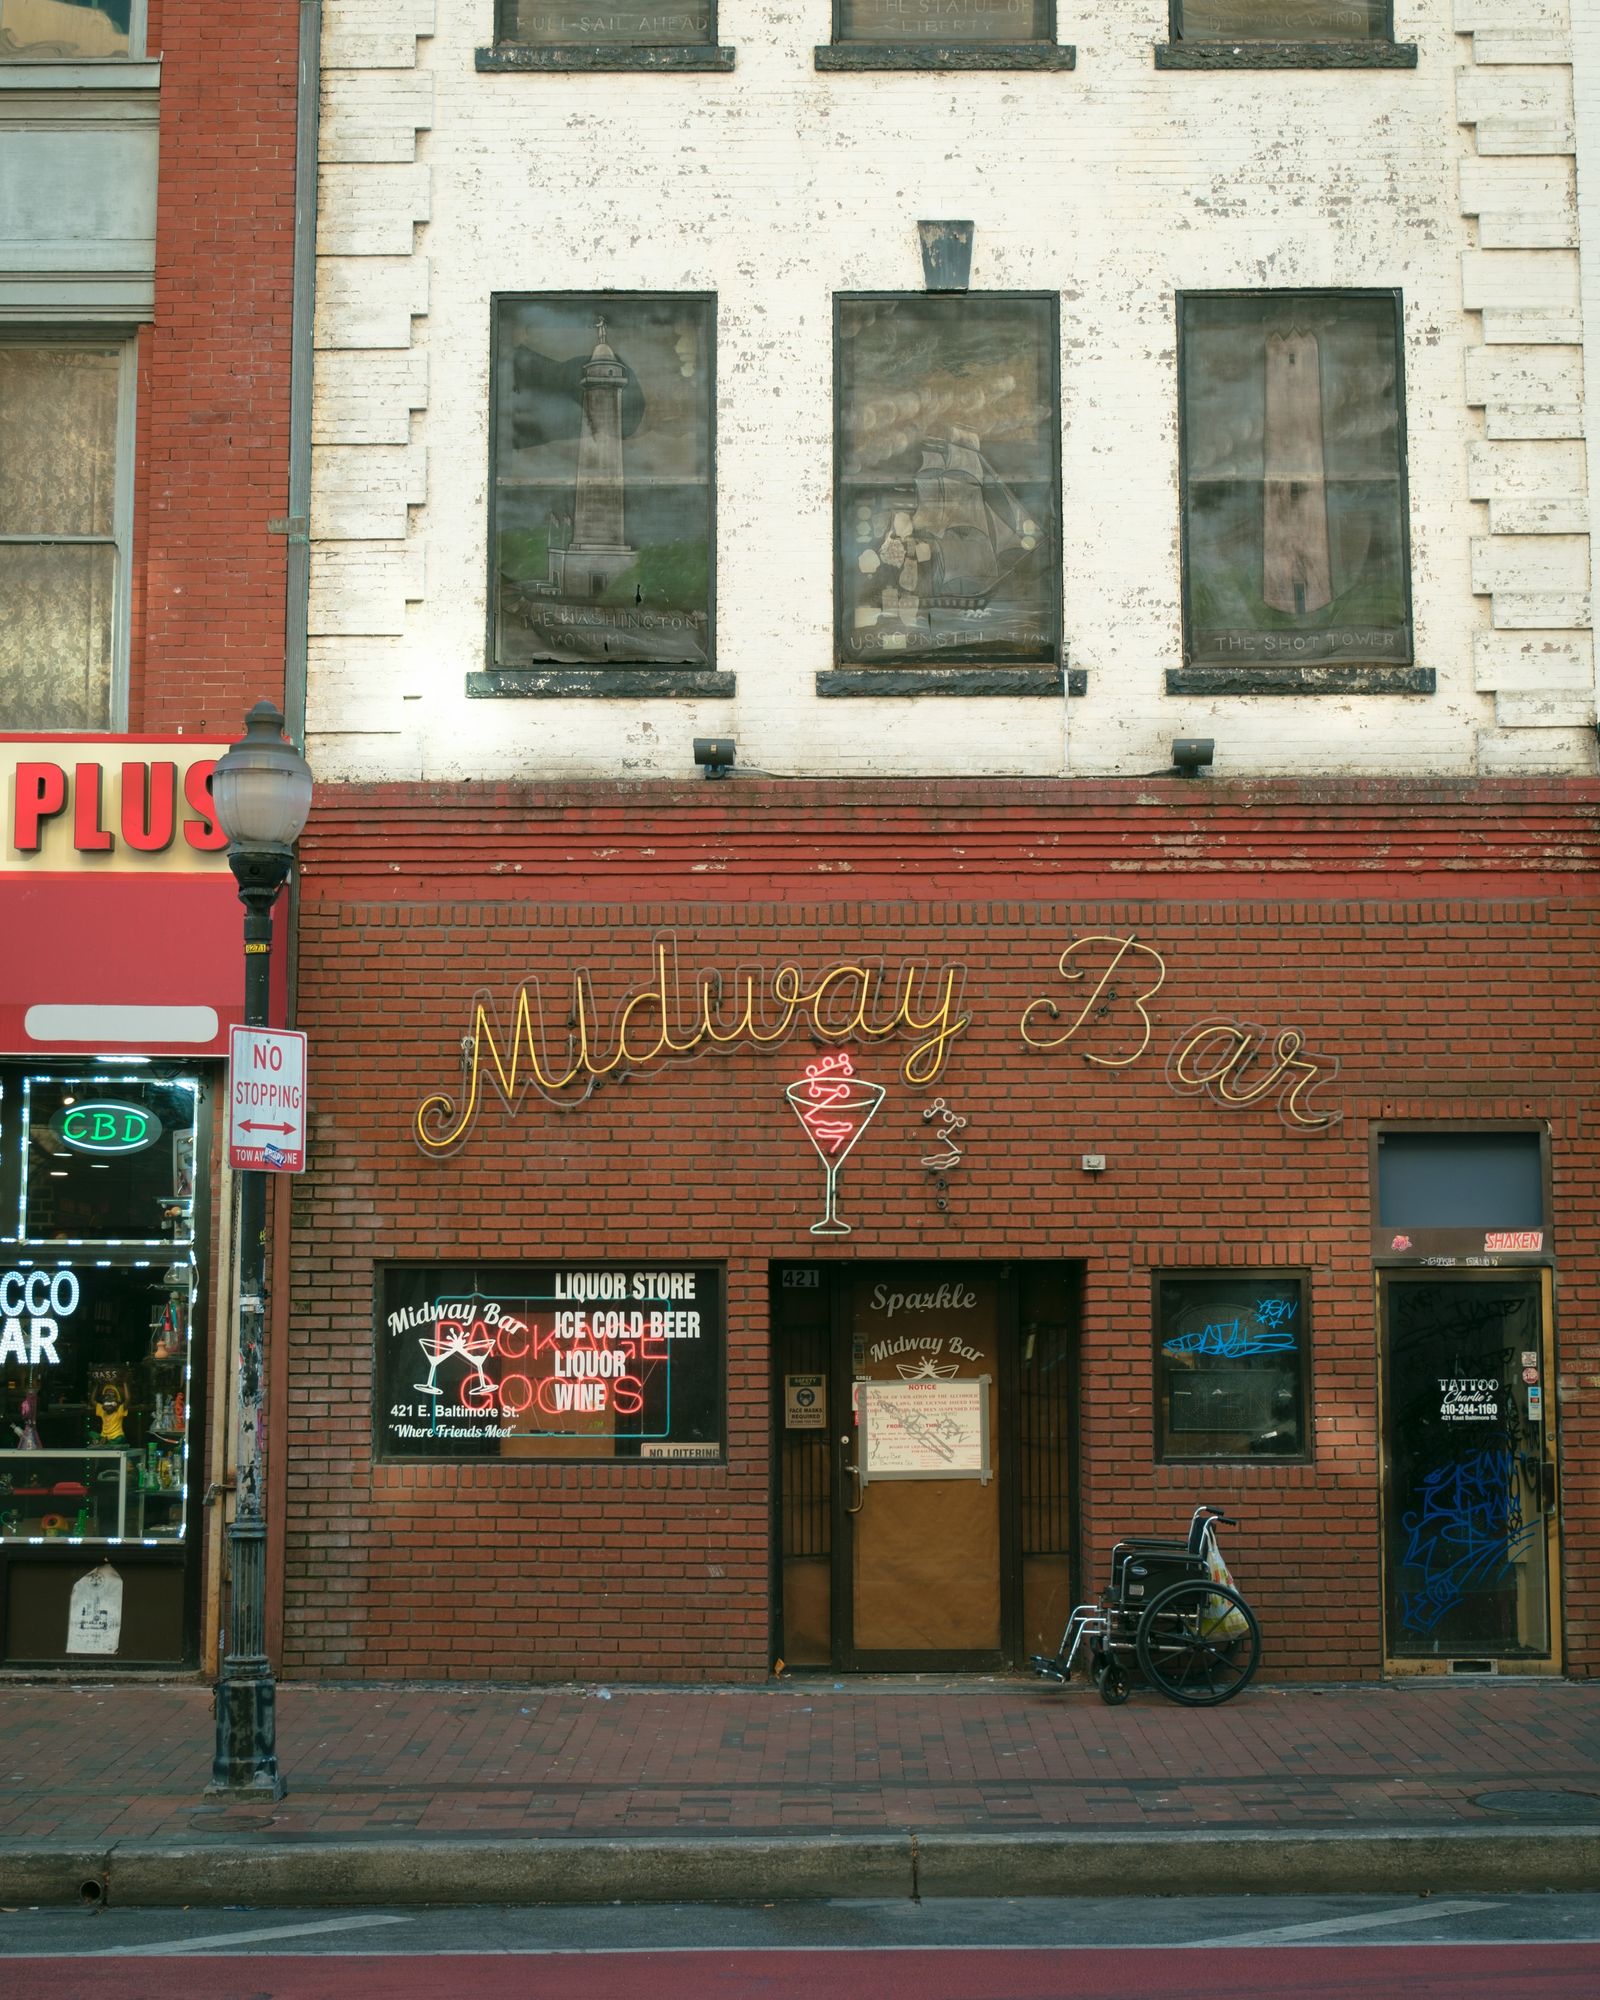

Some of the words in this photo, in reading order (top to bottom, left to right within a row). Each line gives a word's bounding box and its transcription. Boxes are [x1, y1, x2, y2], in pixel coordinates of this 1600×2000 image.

[639, 15, 708, 31] AHEAD
[902, 20, 993, 32] LIBERTY
[521, 611, 564, 629] THE
[571, 615, 699, 631] WASHINGTON
[1214, 637, 1255, 650] THE
[1264, 636, 1319, 651] SHOT
[1326, 633, 1394, 648] TOWER
[14, 759, 231, 852] PLUS
[415, 931, 970, 1155] Midway
[1021, 934, 1341, 1130] Bar
[253, 1044, 282, 1072] NO
[236, 1081, 299, 1109] STOPPING
[63, 1112, 147, 1142] CBD
[236, 1149, 254, 1162] TOW
[1486, 1232, 1540, 1249] SHAKEN
[555, 1273, 626, 1304] LIQUOR
[632, 1272, 696, 1300] STORE
[783, 1271, 817, 1286] 421
[0, 1270, 80, 1317] CCO
[870, 1283, 977, 1317] Sparkle
[387, 1302, 477, 1337] Midway
[483, 1302, 528, 1337] Bar
[555, 1311, 587, 1339] ICE
[592, 1311, 643, 1339] COLD
[651, 1311, 700, 1339] BEER
[0, 1318, 60, 1364] AR
[434, 1320, 669, 1361] PACKAGE
[870, 1336, 943, 1363] Midway
[948, 1337, 985, 1362] Bar
[554, 1349, 626, 1382] LIQUOR
[459, 1374, 644, 1415] GOODS
[555, 1384, 606, 1411] WINE
[1437, 1379, 1499, 1391] TATTOO
[1443, 1389, 1493, 1404] Charlie's
[390, 1404, 412, 1417] 421
[417, 1404, 430, 1417] E.
[435, 1404, 498, 1418] Baltimore
[502, 1405, 519, 1418] St.
[1440, 1403, 1498, 1415] 410-244-1160
[435, 1424, 482, 1438] Friends
